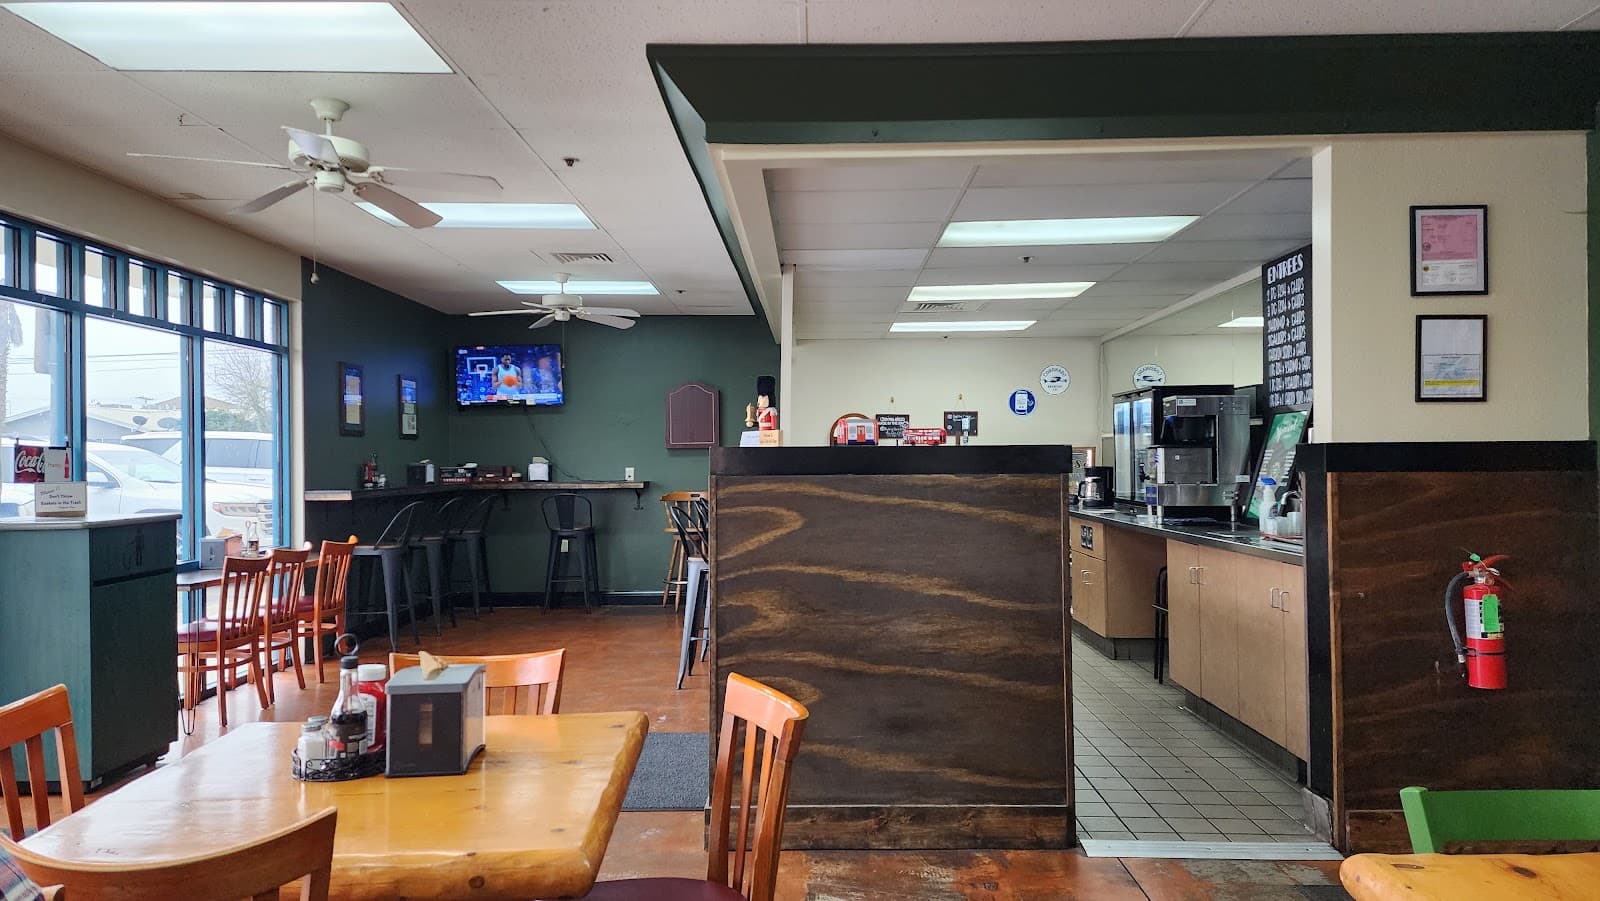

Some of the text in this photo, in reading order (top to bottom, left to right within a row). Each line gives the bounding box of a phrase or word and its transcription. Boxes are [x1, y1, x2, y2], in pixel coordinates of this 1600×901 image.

[1267, 253, 1304, 285] ENTREES
[1290, 277, 1304, 295] CHIPS
[1291, 293, 1305, 310] CHIPS
[1291, 310, 1306, 327] CHIPS
[1291, 325, 1306, 342] CHIPS
[15, 450, 45, 474] Coca-C
